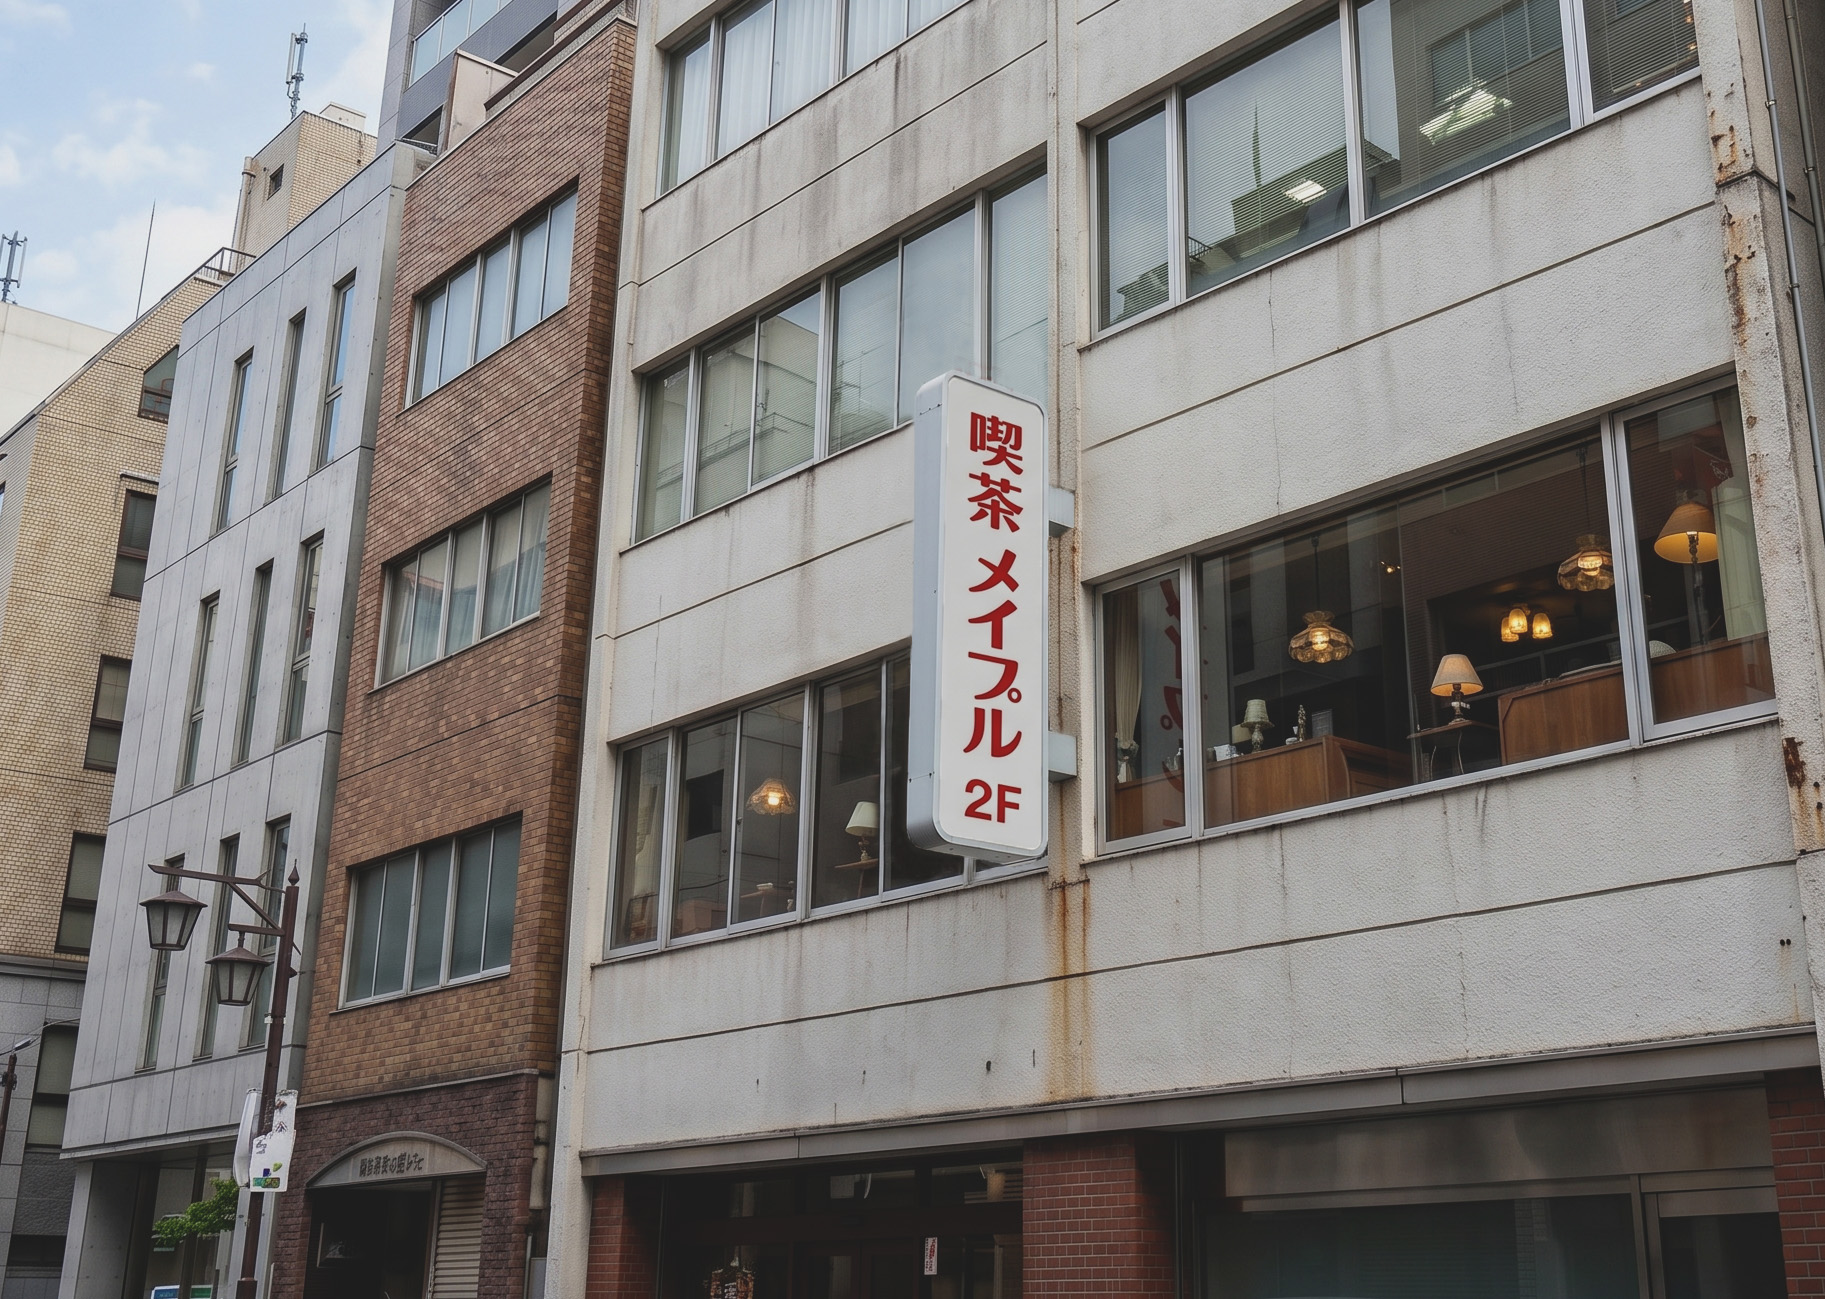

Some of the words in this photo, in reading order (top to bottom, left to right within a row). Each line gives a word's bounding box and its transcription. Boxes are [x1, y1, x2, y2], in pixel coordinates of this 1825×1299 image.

[968, 412, 1023, 532] 喫茶
[963, 549, 1022, 758] メイプル
[964, 778, 1022, 824] 2F
